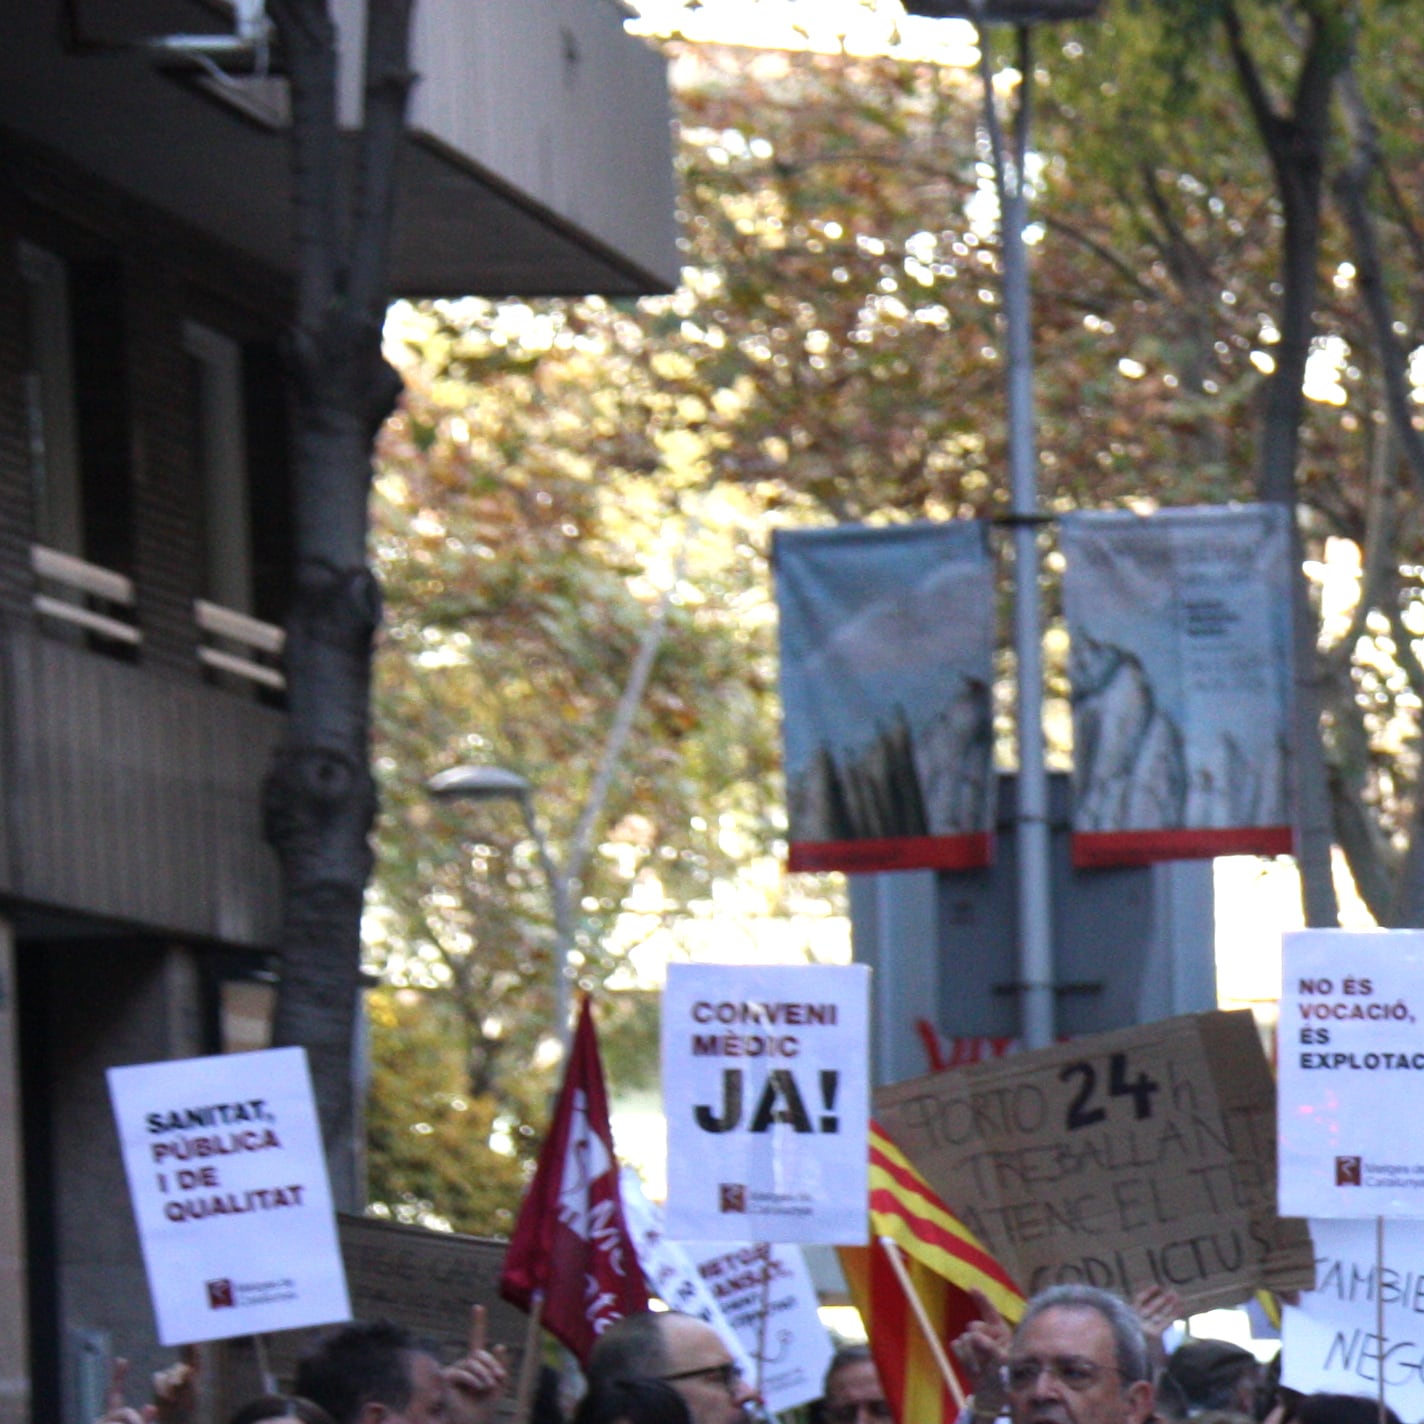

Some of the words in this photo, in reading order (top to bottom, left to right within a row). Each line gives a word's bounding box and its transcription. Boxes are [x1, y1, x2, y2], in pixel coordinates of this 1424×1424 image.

[1298, 978, 1334, 996] NO
[1342, 974, 1373, 996] ÉS
[691, 1001, 839, 1026] CONVENI
[1298, 998, 1417, 1025] VOCACIÓ,
[691, 1029, 800, 1057] MÈDIC
[1299, 1024, 1331, 1046] ÉS
[693, 1068, 841, 1134] JA!
[1058, 1052, 1159, 1132] 24
[146, 1100, 276, 1135] SANITAT,
[156, 1172, 168, 1193] I
[176, 1166, 220, 1191] DE
[164, 1184, 305, 1223] QUALITAT
